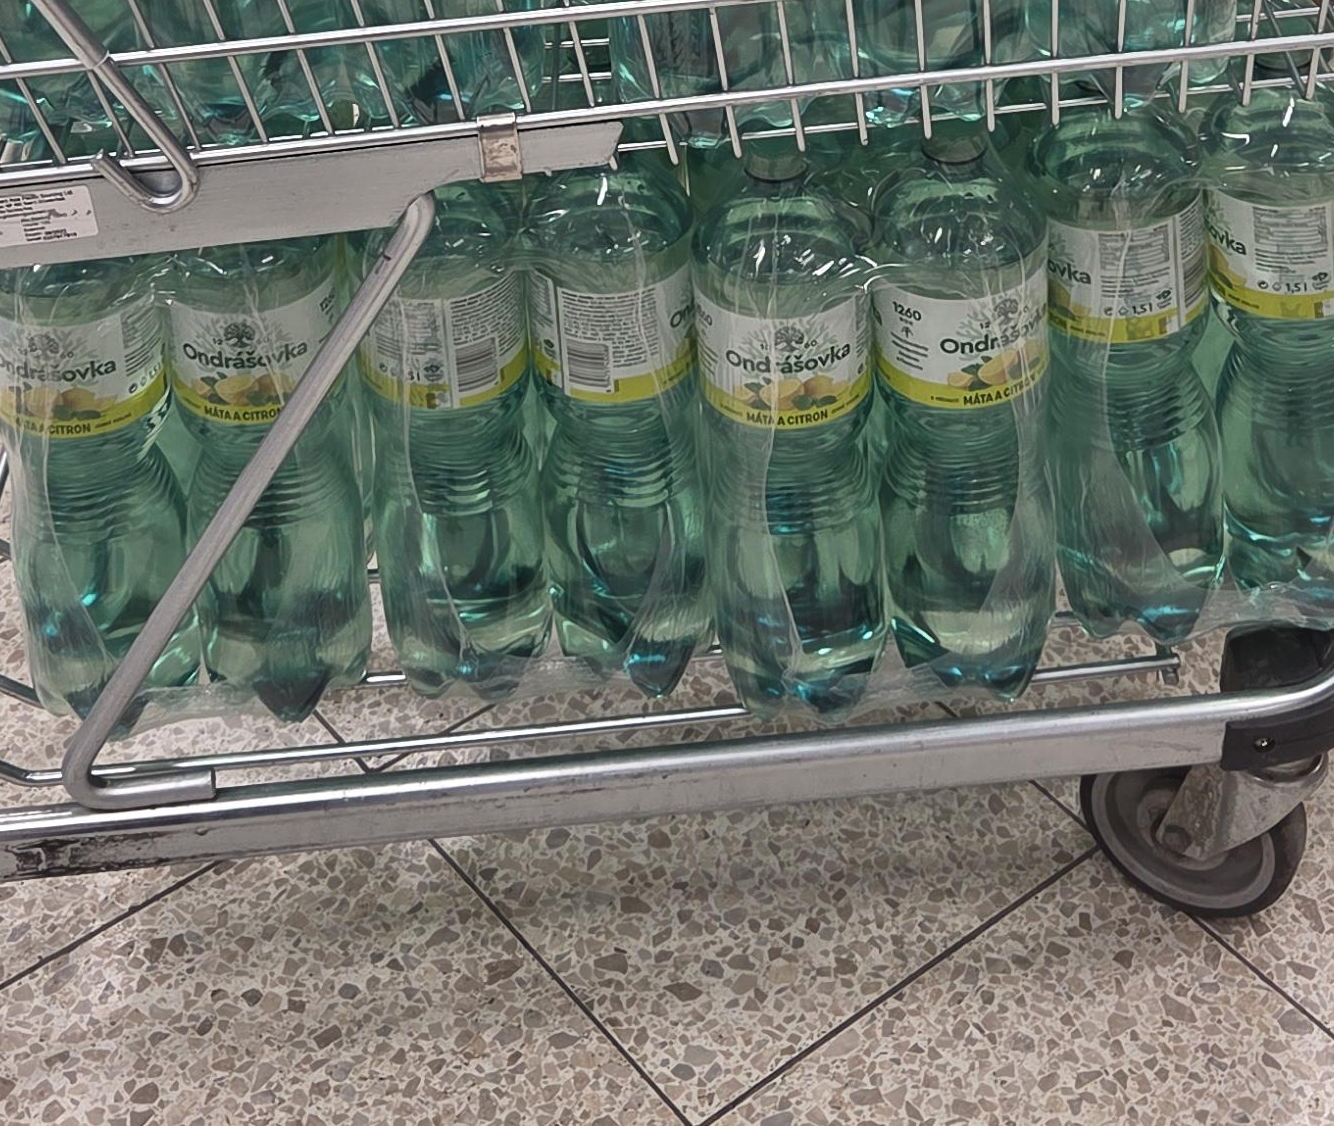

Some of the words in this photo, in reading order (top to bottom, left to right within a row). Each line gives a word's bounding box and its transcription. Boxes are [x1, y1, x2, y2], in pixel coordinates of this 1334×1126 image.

[1285, 283, 1302, 293] 1,5
[892, 301, 922, 322] 1260
[183, 341, 308, 370] Ondrášovka
[963, 393, 994, 406] MÁTA
[204, 405, 232, 420] MÁTA
[787, 410, 828, 425] CITRON
[49, 423, 92, 435] CITRON
